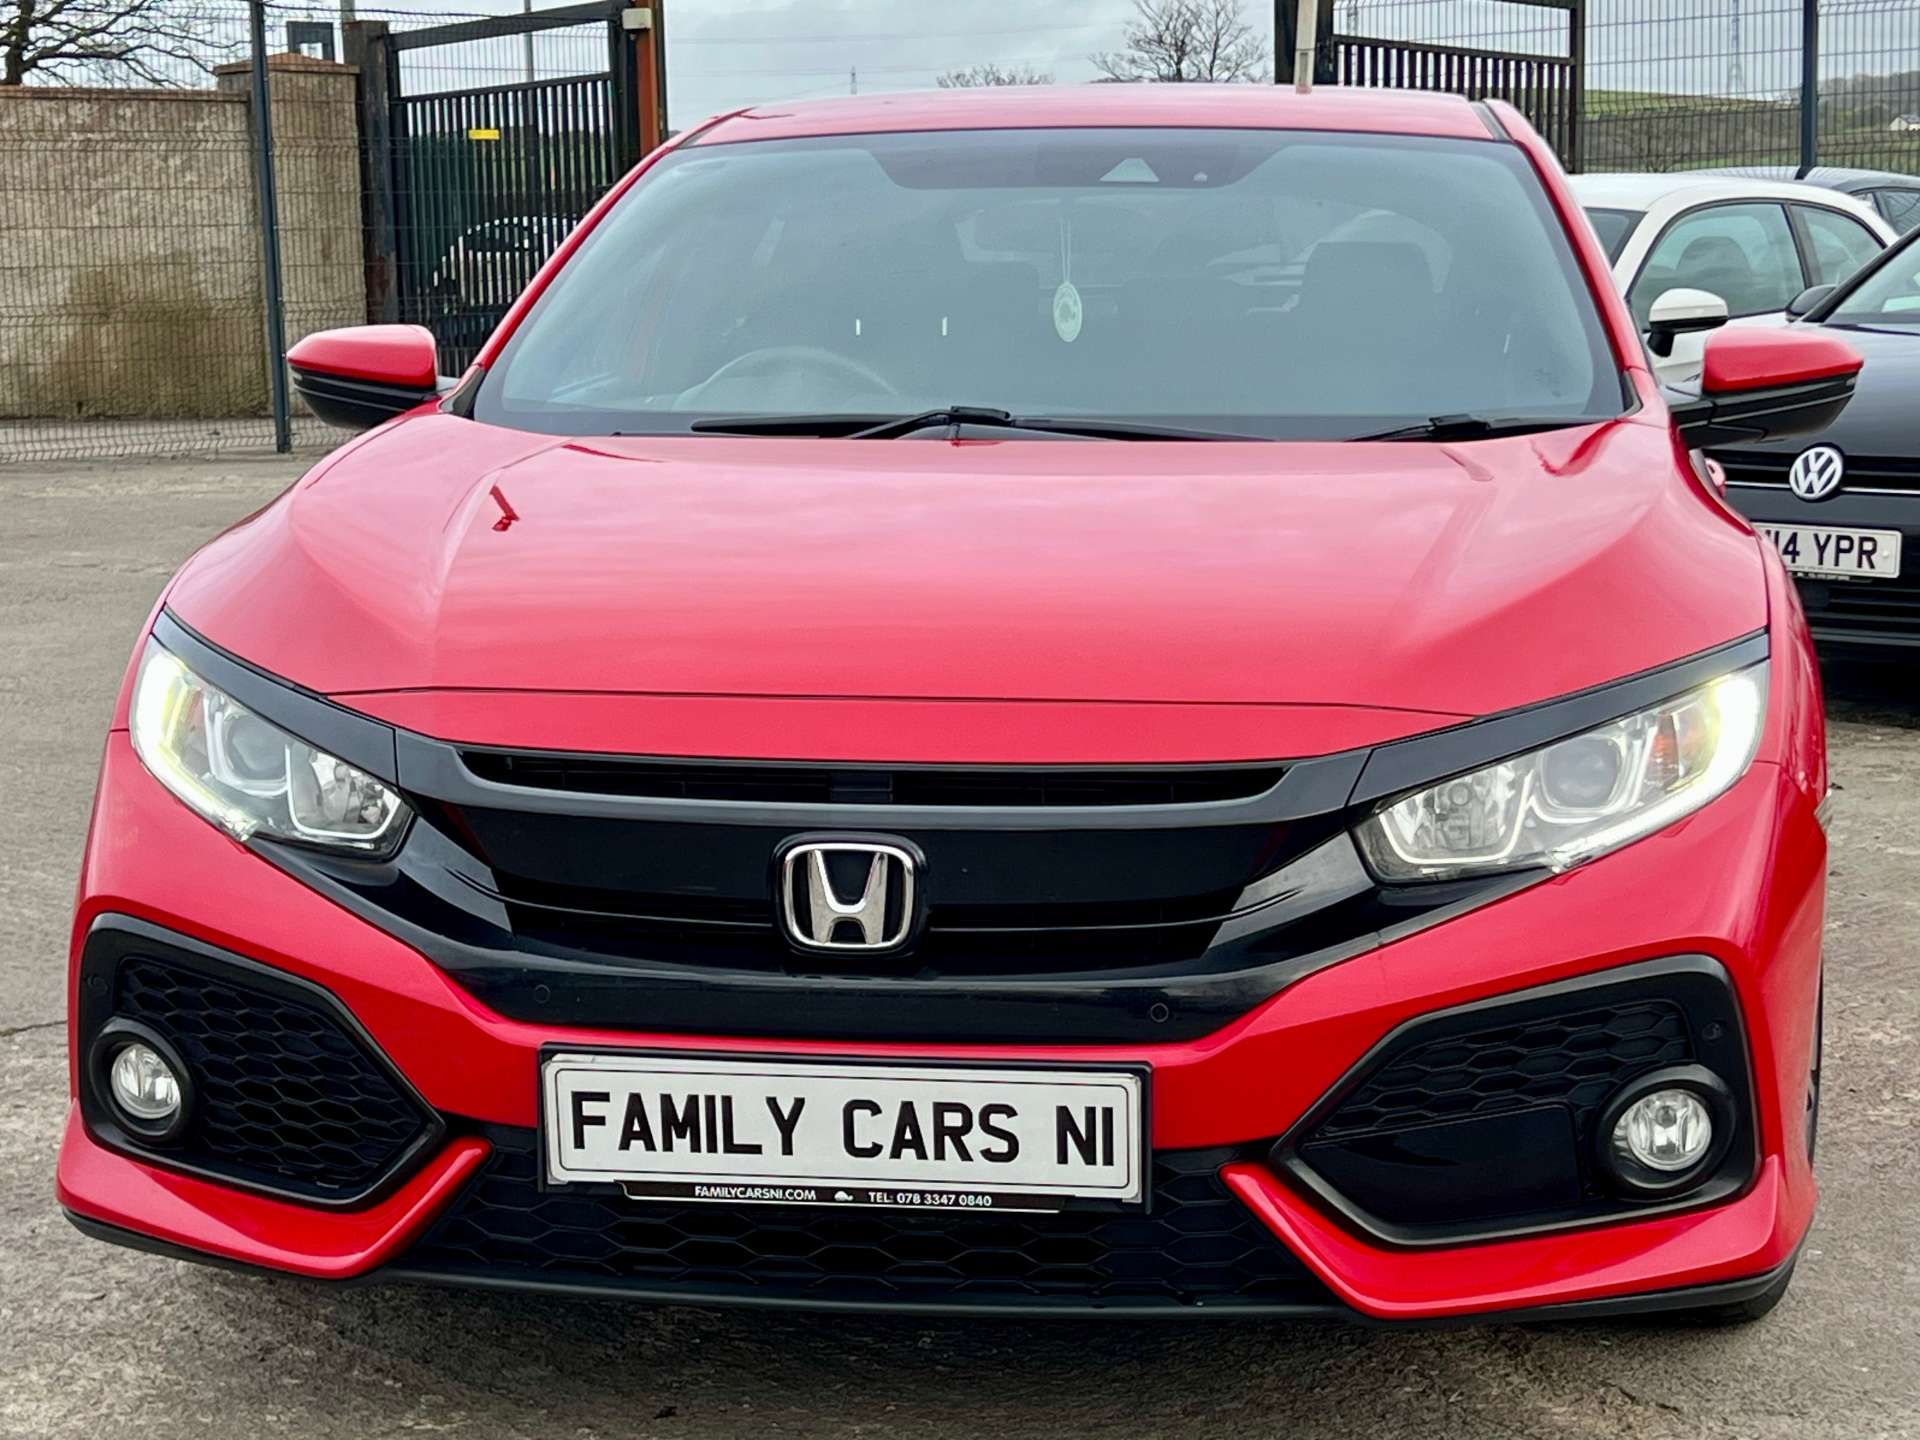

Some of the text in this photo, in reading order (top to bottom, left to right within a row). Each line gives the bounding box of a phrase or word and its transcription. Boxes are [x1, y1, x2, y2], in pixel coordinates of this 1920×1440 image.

[1790, 447, 1842, 498] VW
[1813, 533, 1877, 569] YPR
[570, 1090, 1115, 1167] FAMILY CARS NI
[694, 1185, 817, 1201] FAMILYCARSNI.COM
[868, 1191, 992, 1206] TEL: 078 3347 0840
